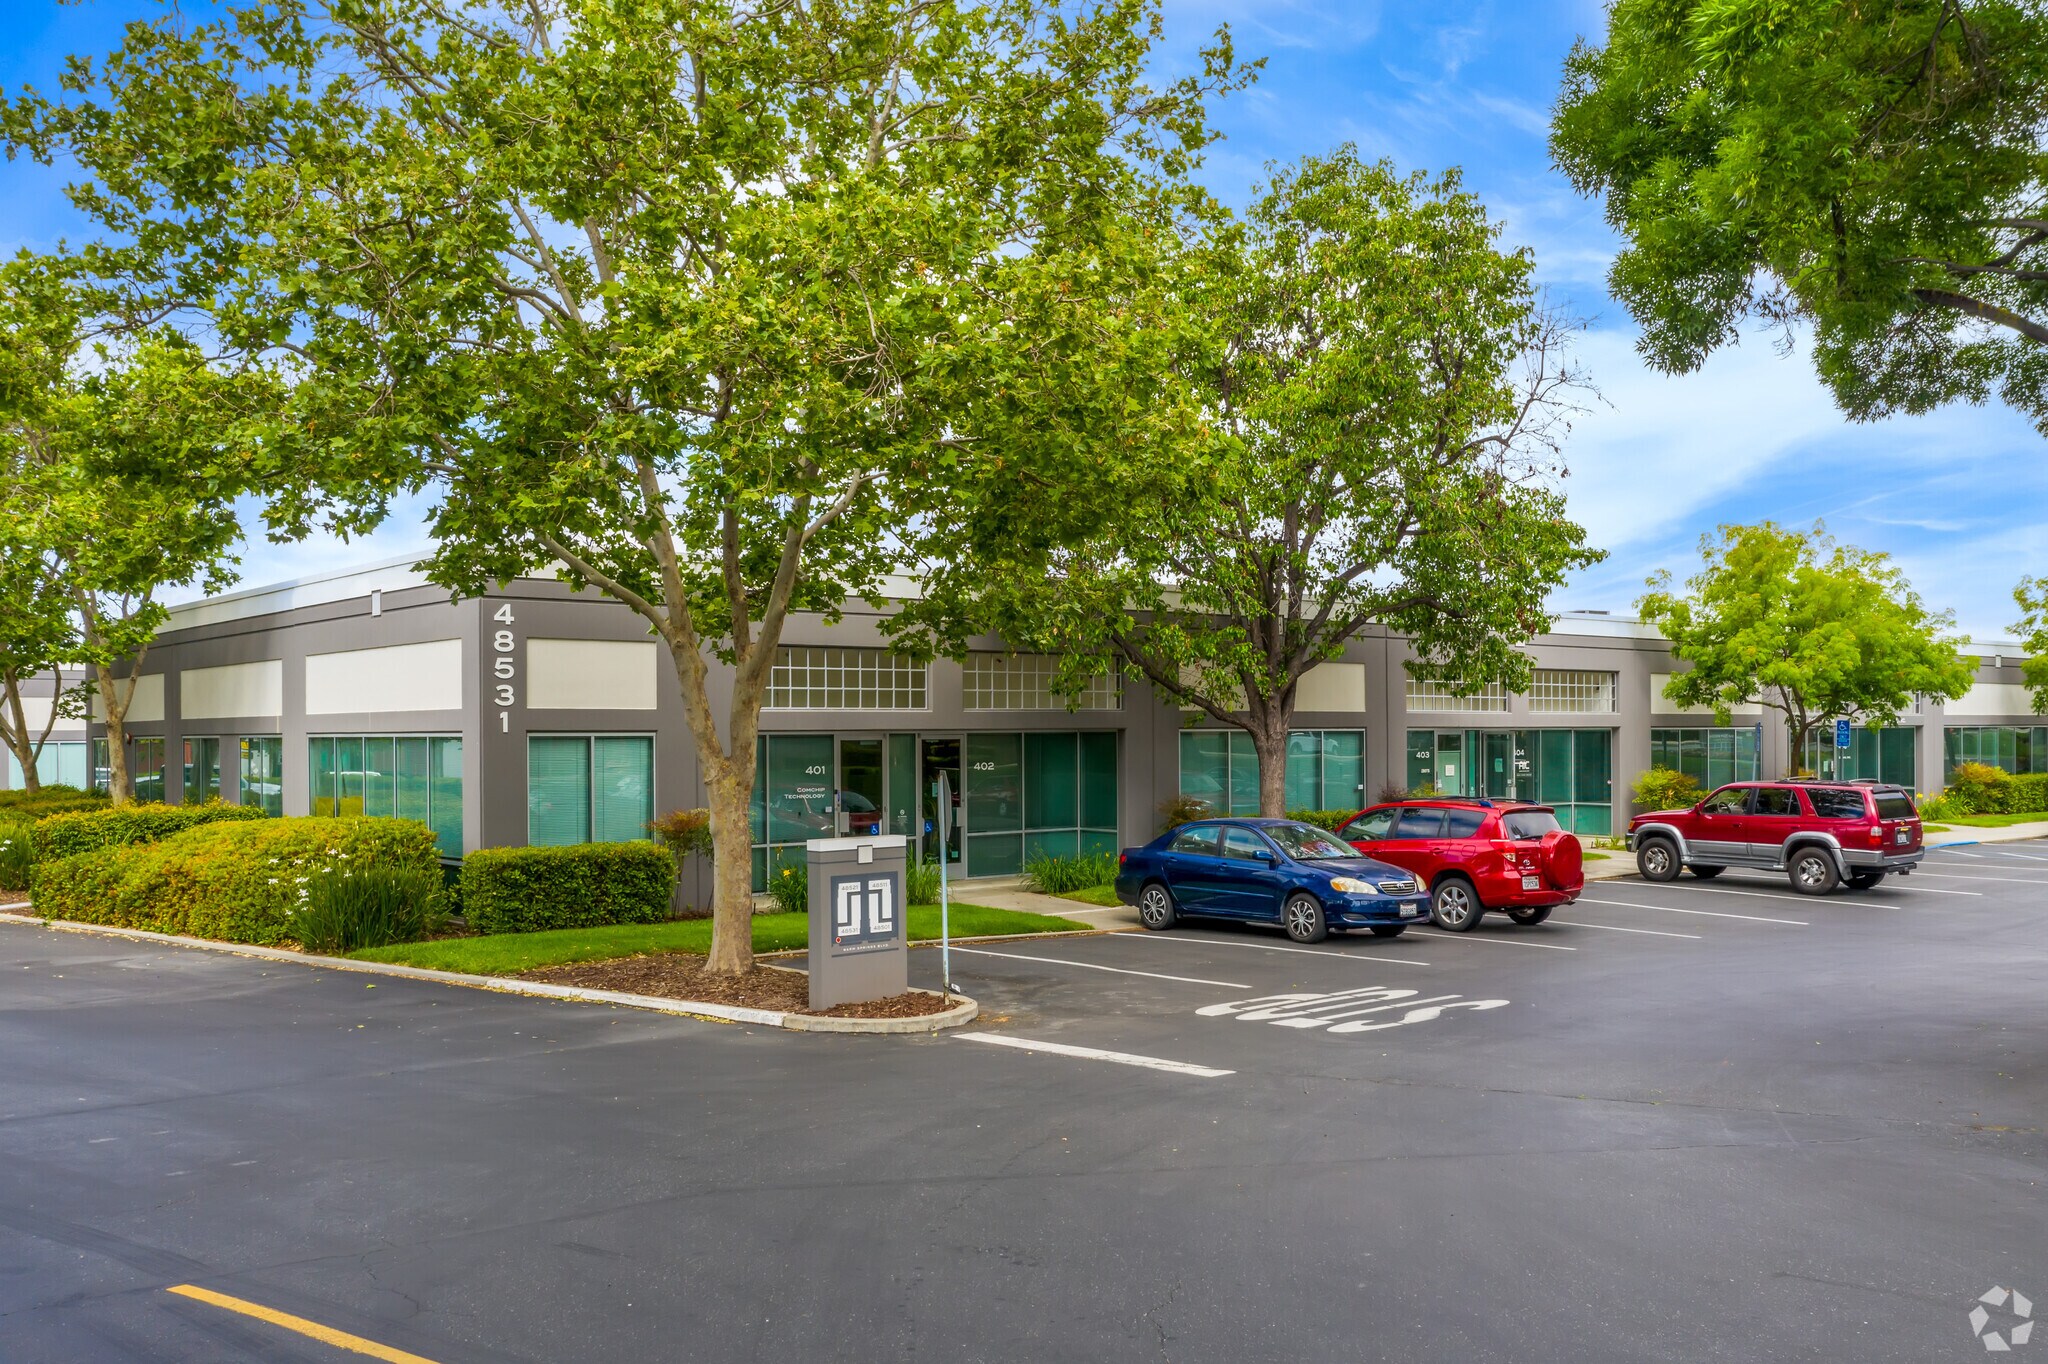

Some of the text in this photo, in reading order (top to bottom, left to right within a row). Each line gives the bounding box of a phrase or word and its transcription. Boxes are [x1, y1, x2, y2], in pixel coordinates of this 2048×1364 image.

[493, 603, 515, 733] 48531
[1416, 751, 1430, 759] 403
[805, 765, 826, 775] 401
[973, 762, 995, 771] 402
